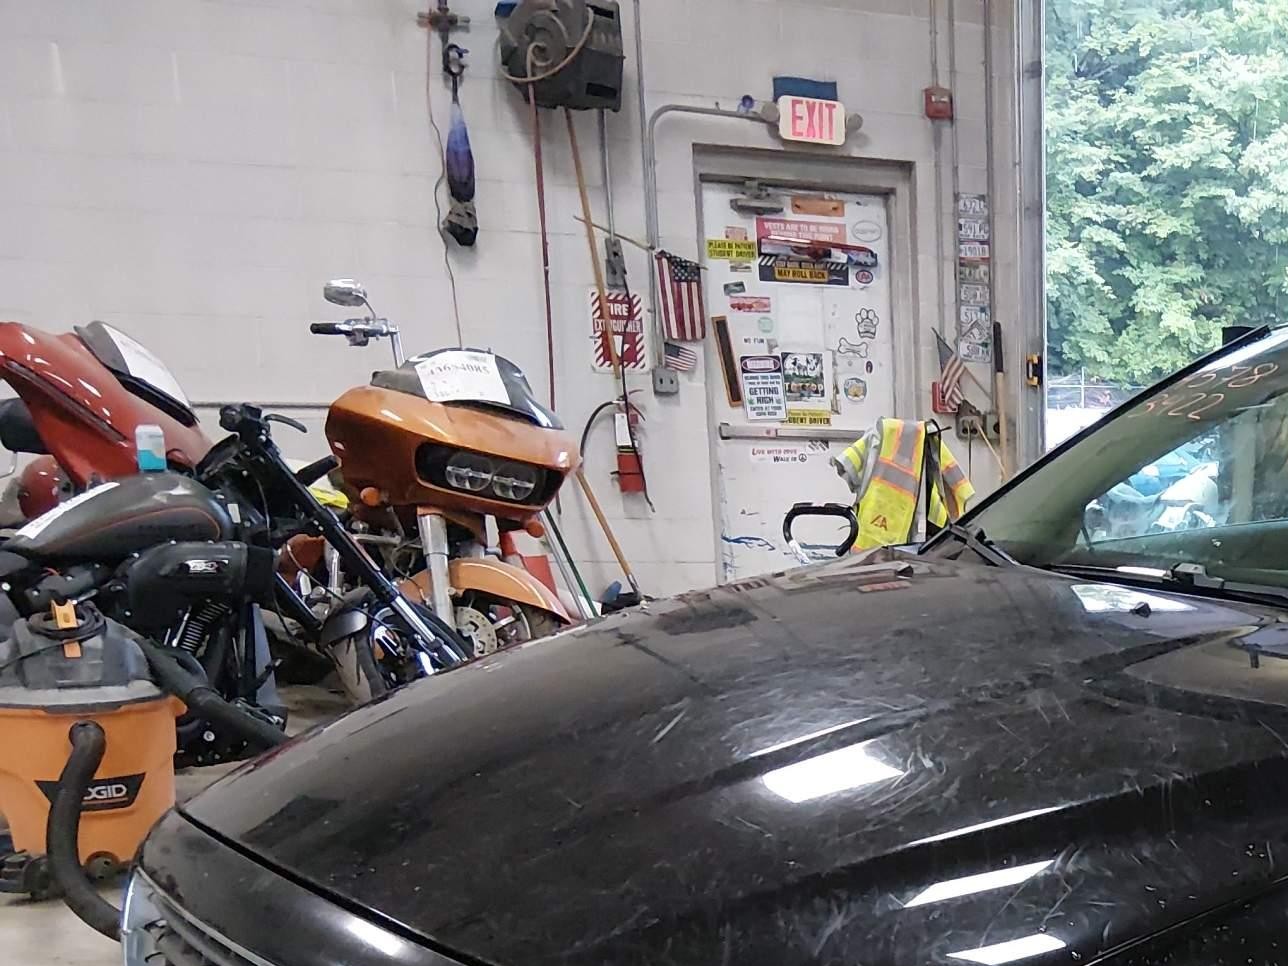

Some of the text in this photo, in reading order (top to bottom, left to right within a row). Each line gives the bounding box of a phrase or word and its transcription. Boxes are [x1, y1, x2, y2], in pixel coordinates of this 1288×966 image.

[791, 99, 836, 140] EXIT
[777, 269, 826, 280] MAY ROLL BACK
[606, 303, 629, 316] IRE
[749, 386, 779, 395] GETTING
